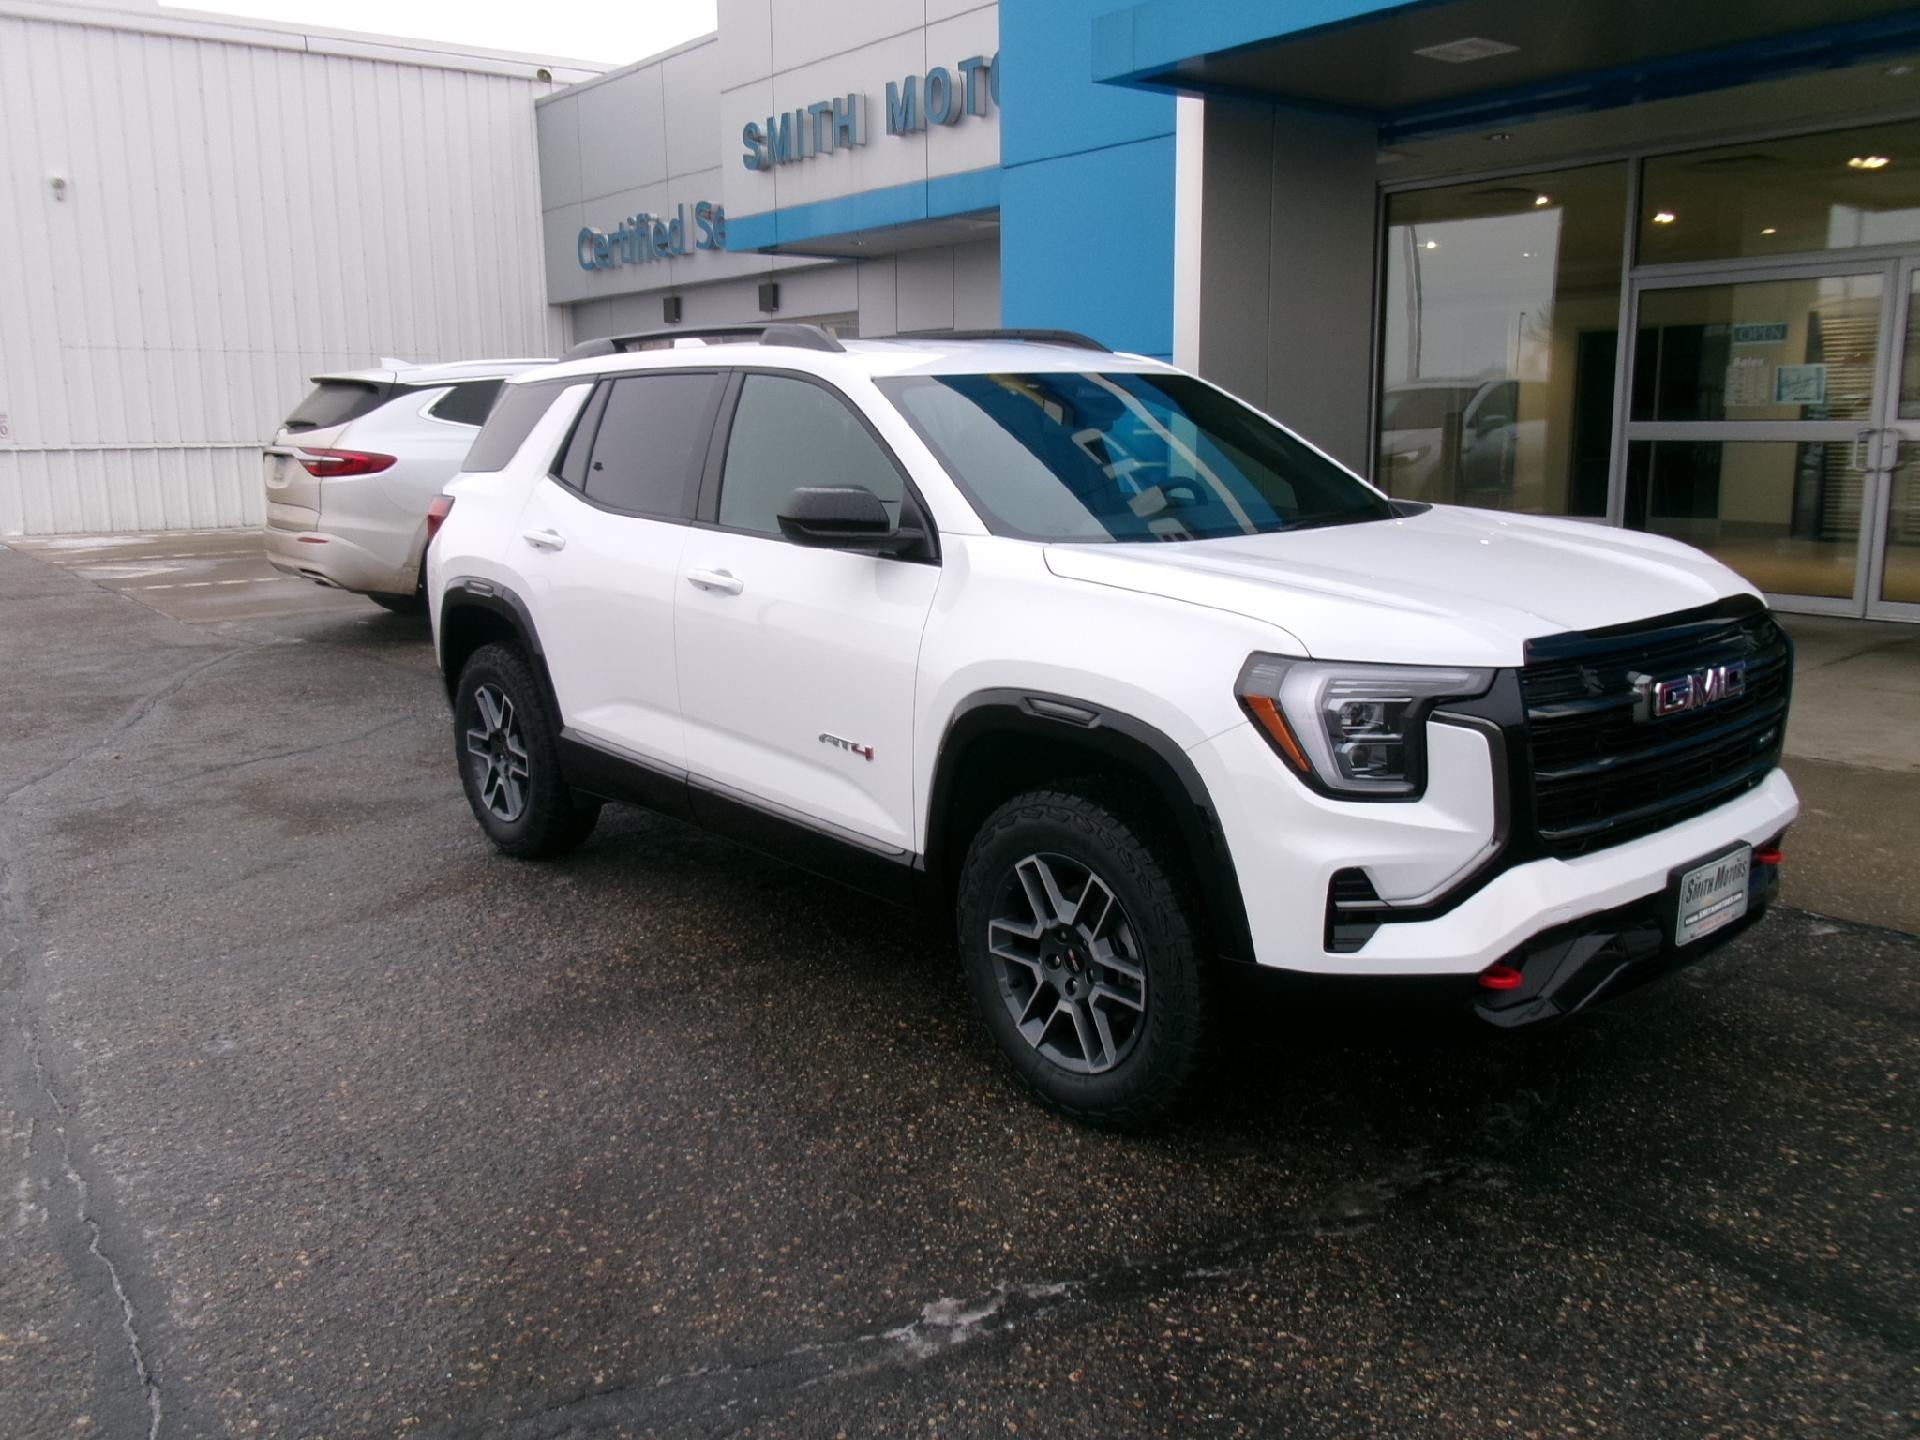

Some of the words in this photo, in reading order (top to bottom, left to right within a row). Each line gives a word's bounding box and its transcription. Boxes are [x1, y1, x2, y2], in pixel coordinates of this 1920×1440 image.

[743, 93, 865, 171] SMITH
[886, 52, 1000, 136] MOT
[577, 203, 690, 271] Certified
[1738, 327, 1784, 342] OPEN
[1655, 661, 1745, 716] GMC
